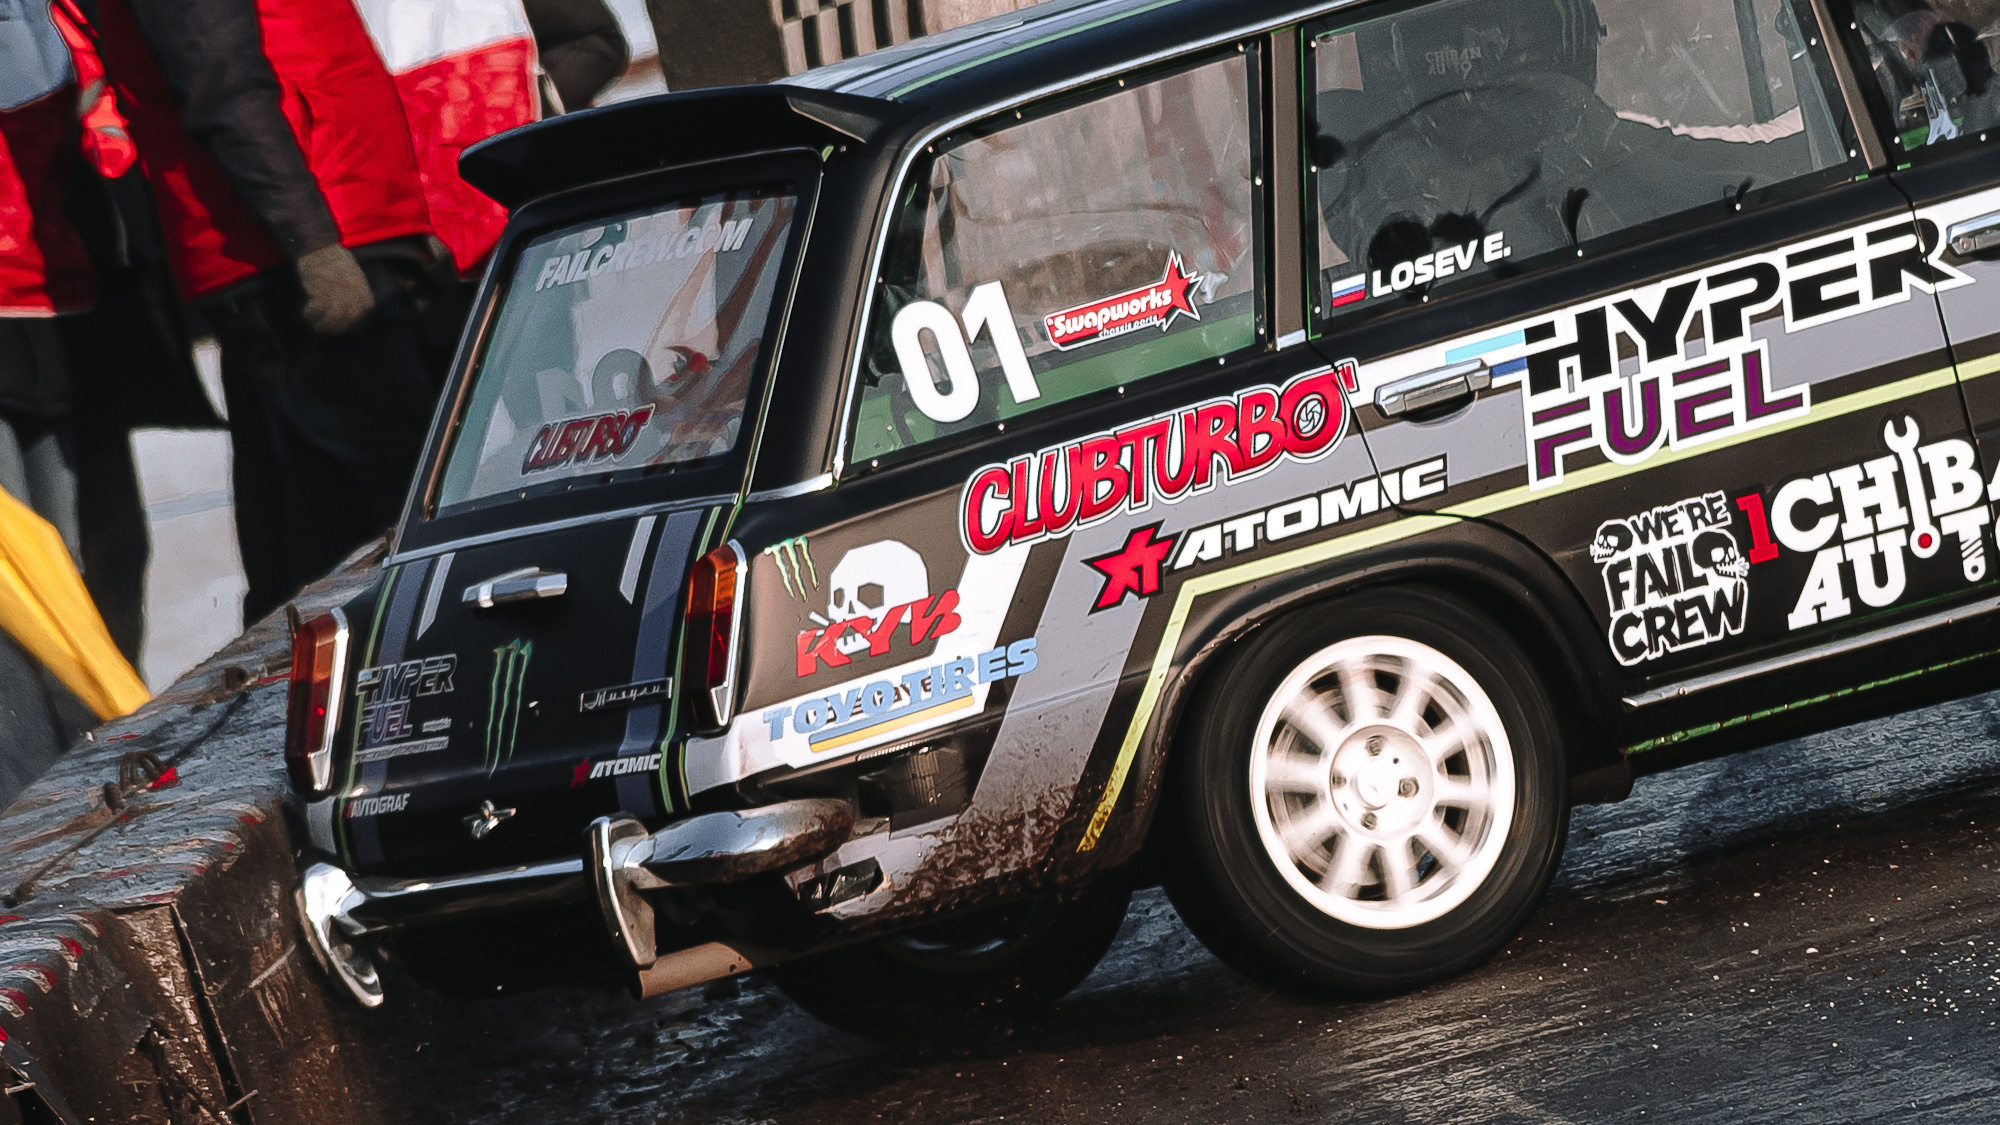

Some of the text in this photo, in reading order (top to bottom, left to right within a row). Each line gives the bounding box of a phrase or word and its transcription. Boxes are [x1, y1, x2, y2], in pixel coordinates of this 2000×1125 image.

[535, 217, 754, 292] FAILCREW.COM
[1372, 231, 1511, 298] LOSEV E.
[1054, 288, 1172, 338] Swapworks
[1522, 216, 1962, 396] HYPER
[891, 280, 1041, 423] 01
[1531, 342, 1807, 485] FUEL
[961, 361, 1357, 554] CLUBTURBO
[1173, 458, 1447, 569] ATOMIC
[1629, 493, 1732, 543] WE'RE
[1606, 540, 1708, 612] FAIL
[1787, 504, 2000, 631] AUT
[797, 589, 961, 677] KYB
[1611, 579, 1746, 663] CREW
[356, 653, 457, 706] HYPER
[763, 679, 894, 742] TOYO
[902, 637, 1039, 705] TIRES
[357, 700, 413, 746] FUEL
[590, 753, 662, 779] ATOMIC
